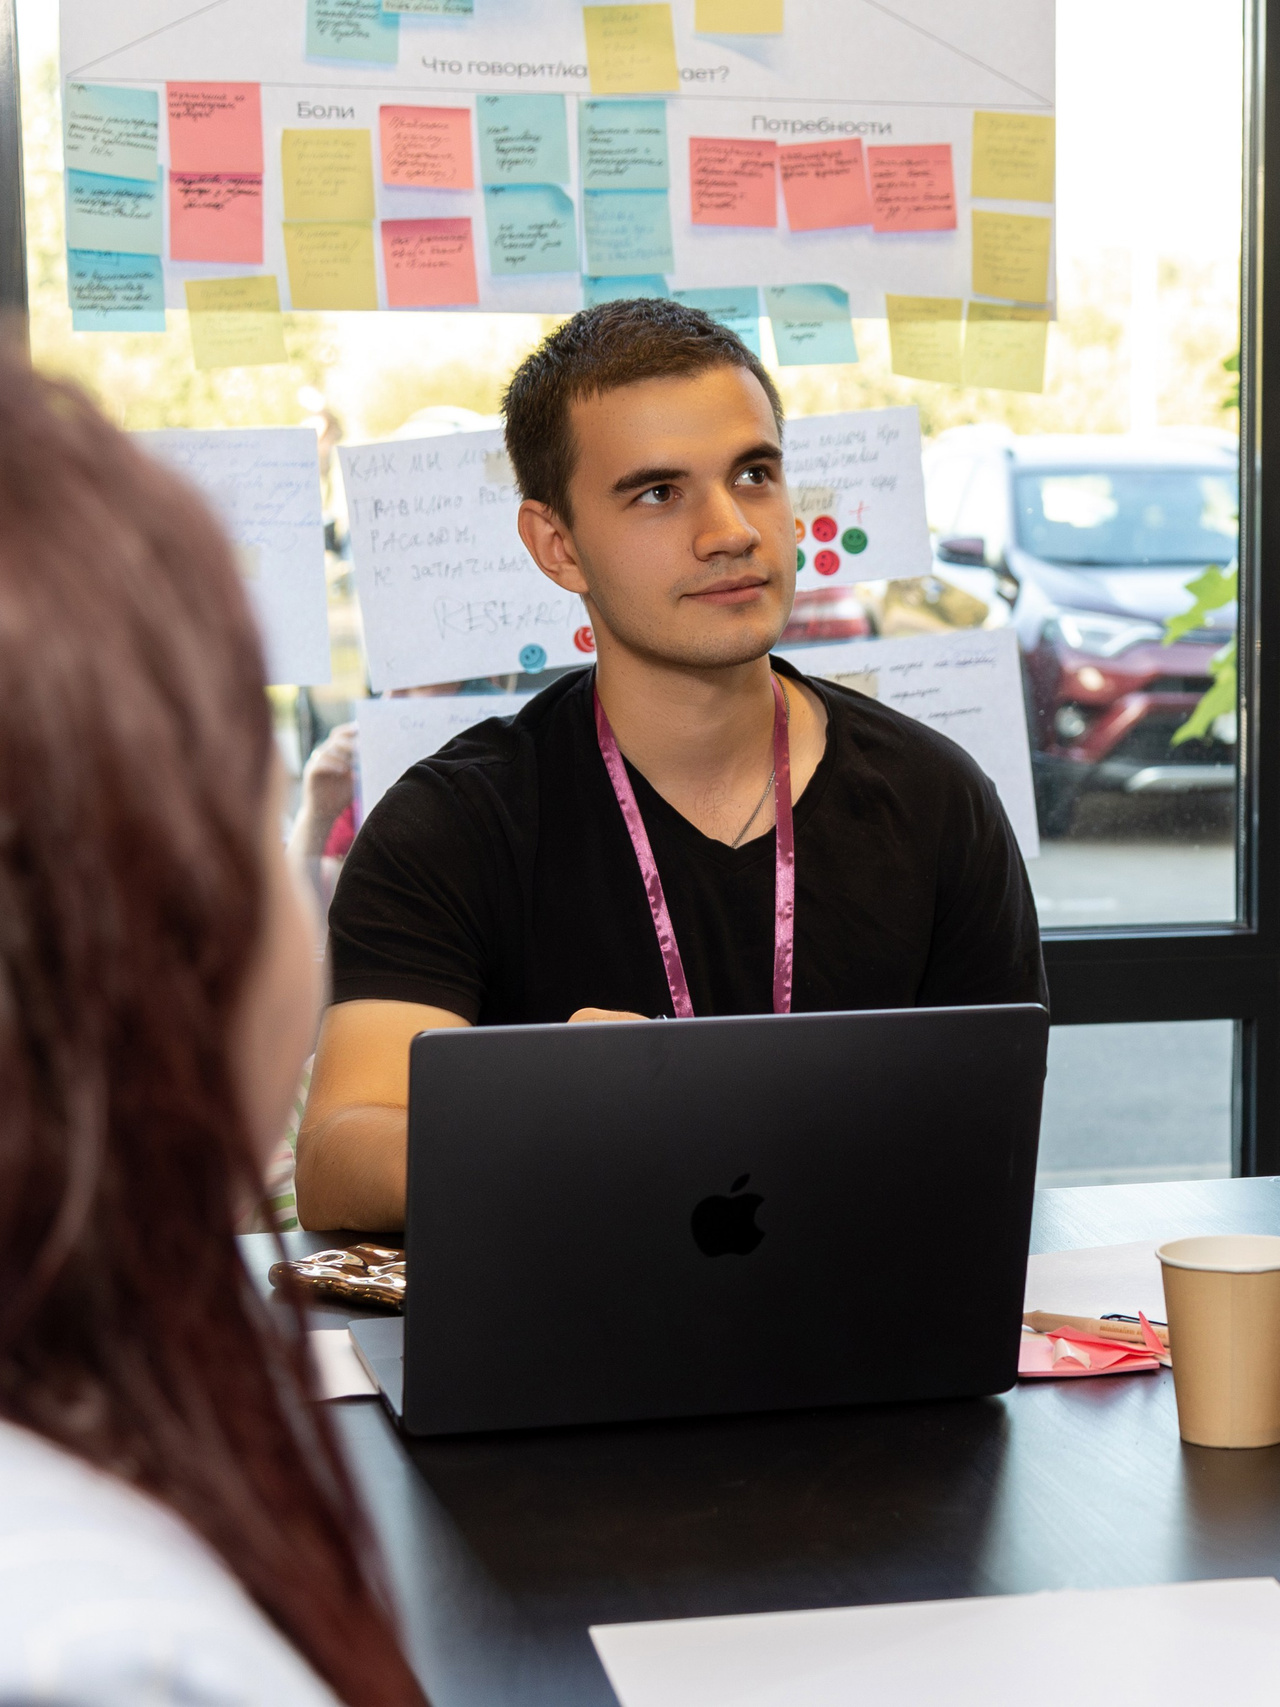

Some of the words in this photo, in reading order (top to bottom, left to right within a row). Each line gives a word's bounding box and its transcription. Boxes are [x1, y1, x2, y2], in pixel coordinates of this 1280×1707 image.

[422, 56, 462, 74] Что
[467, 57, 589, 83] говорит/ка
[680, 65, 730, 83] ает?
[297, 102, 355, 119] Боли
[752, 115, 893, 135] Потребности
[1100, 1325, 1135, 1335] minimalism
